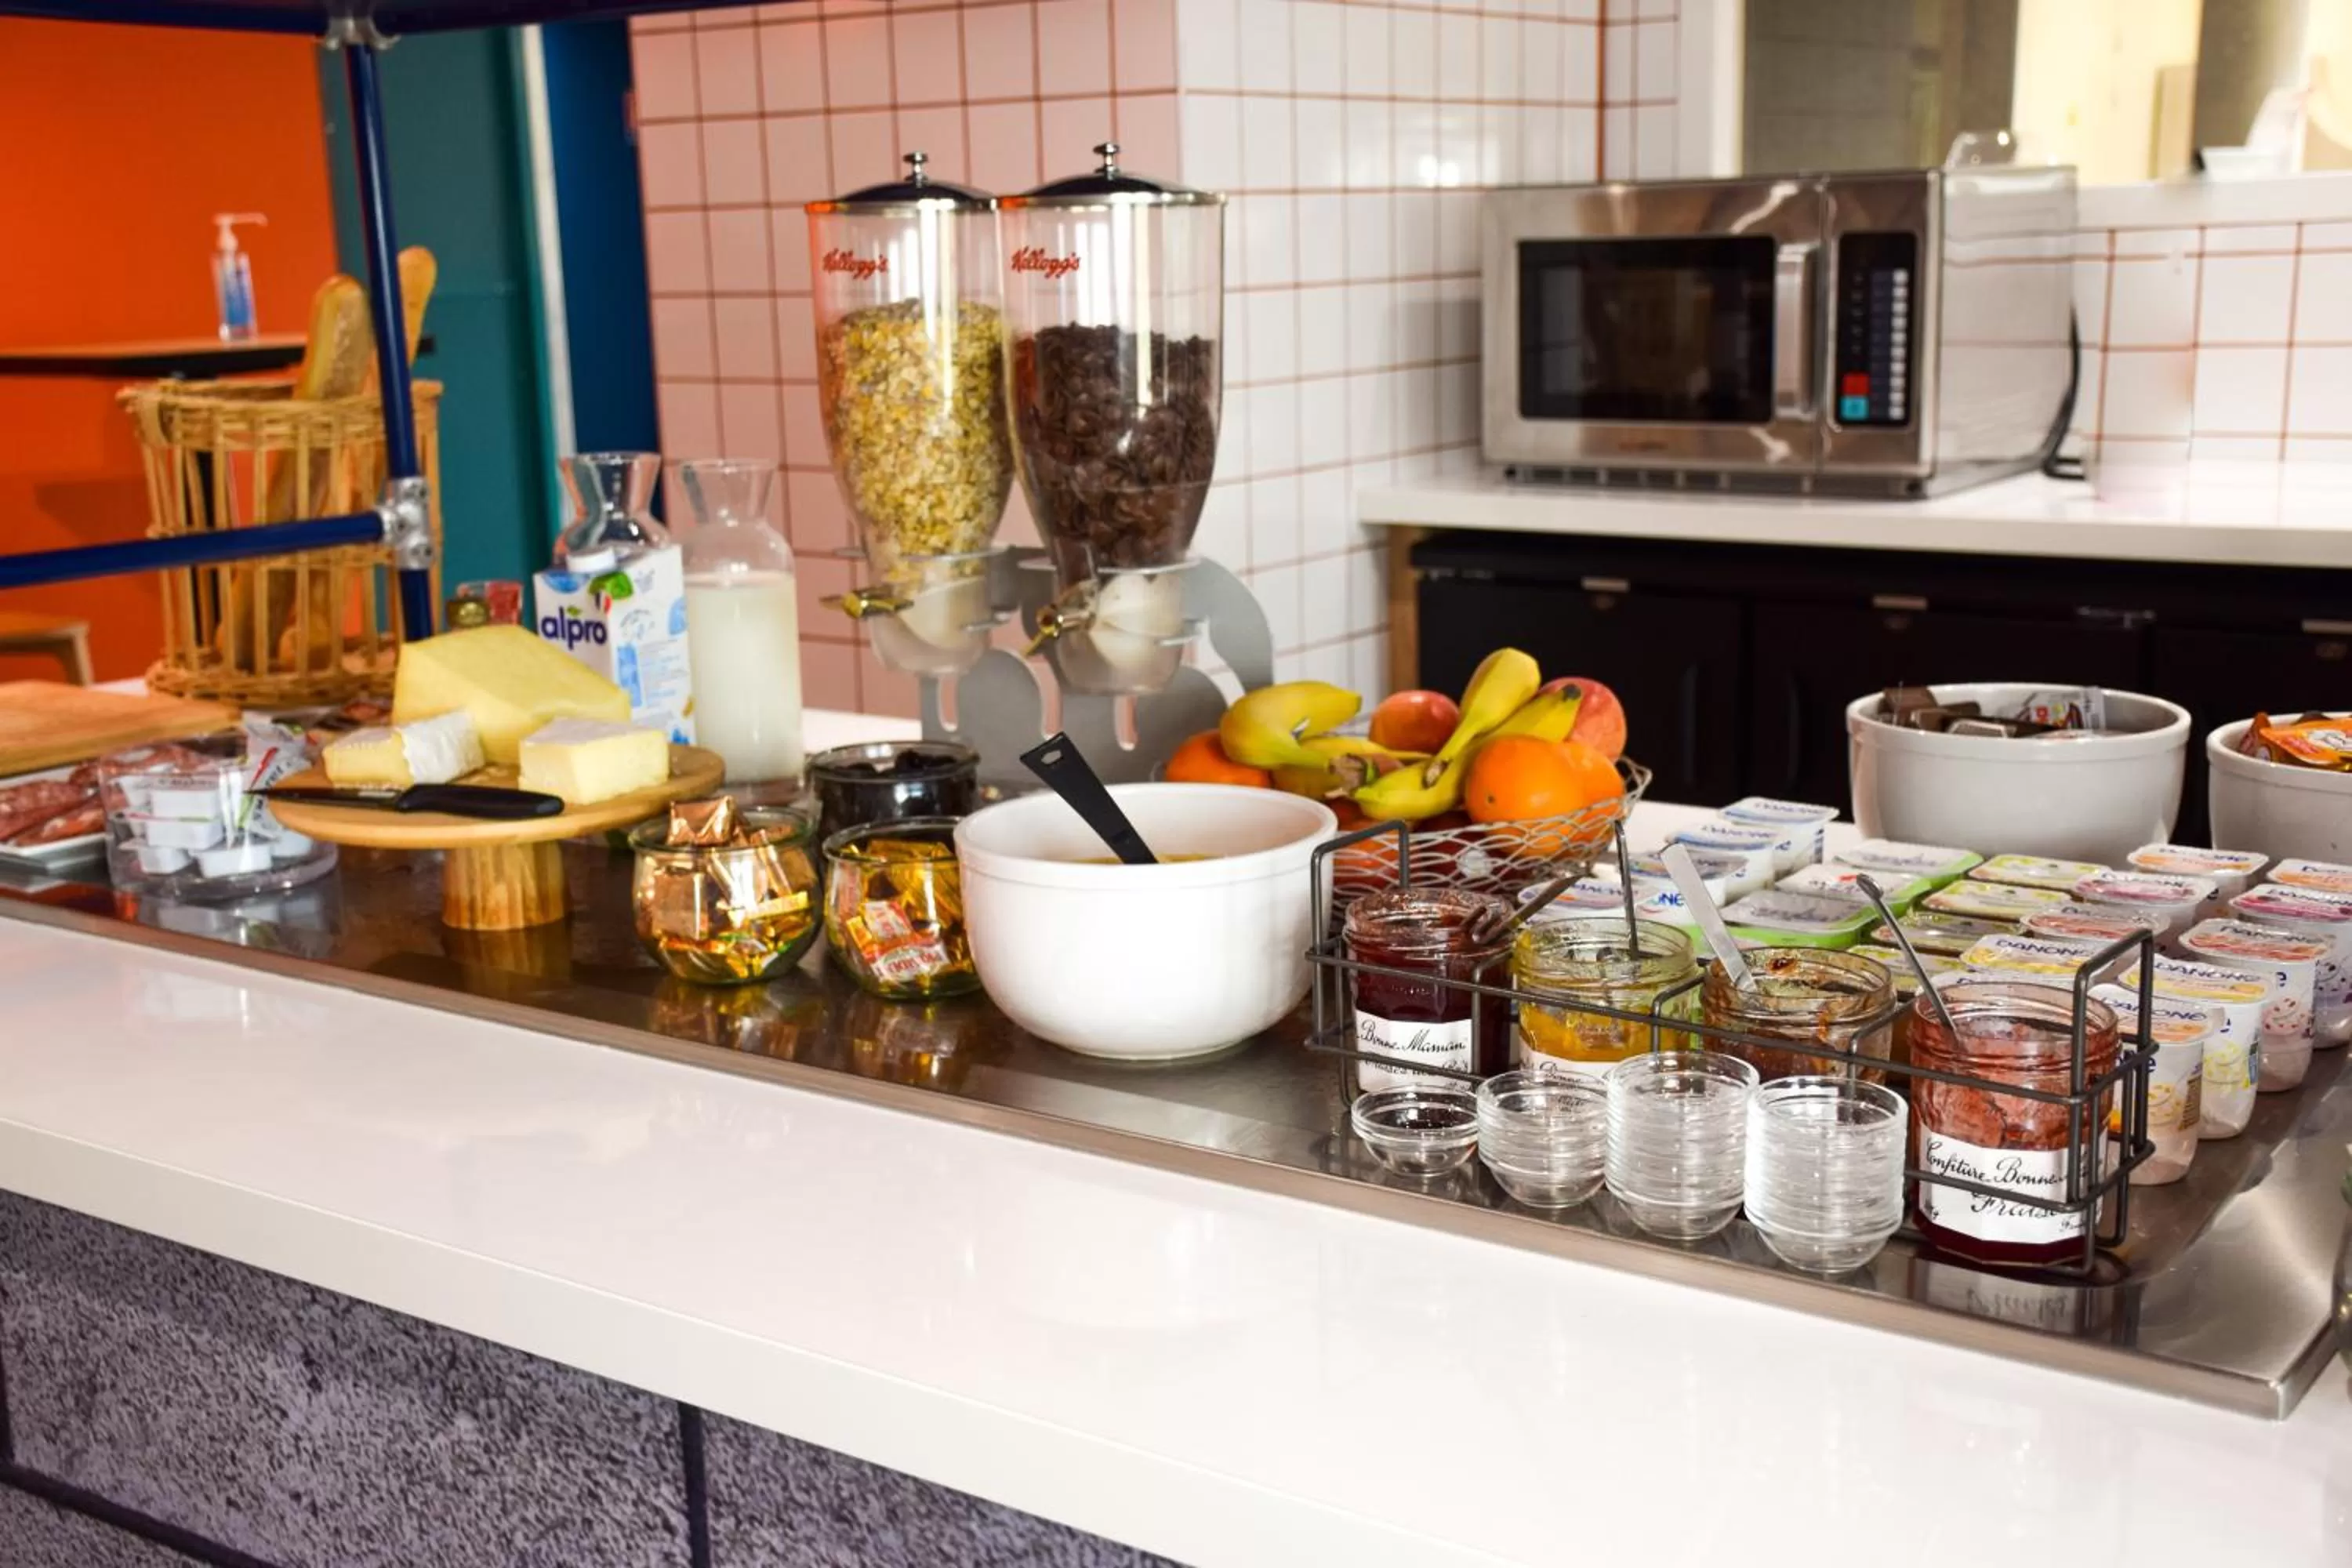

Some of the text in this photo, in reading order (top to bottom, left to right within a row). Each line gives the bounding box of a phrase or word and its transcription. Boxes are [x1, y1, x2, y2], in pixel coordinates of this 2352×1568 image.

[822, 246, 888, 280] Kellogg's
[1011, 246, 1080, 278] Kellogg's
[540, 605, 608, 651] alpro
[2101, 996, 2208, 1021] DAONE
[1357, 1020, 1467, 1053] Bonne Maman
